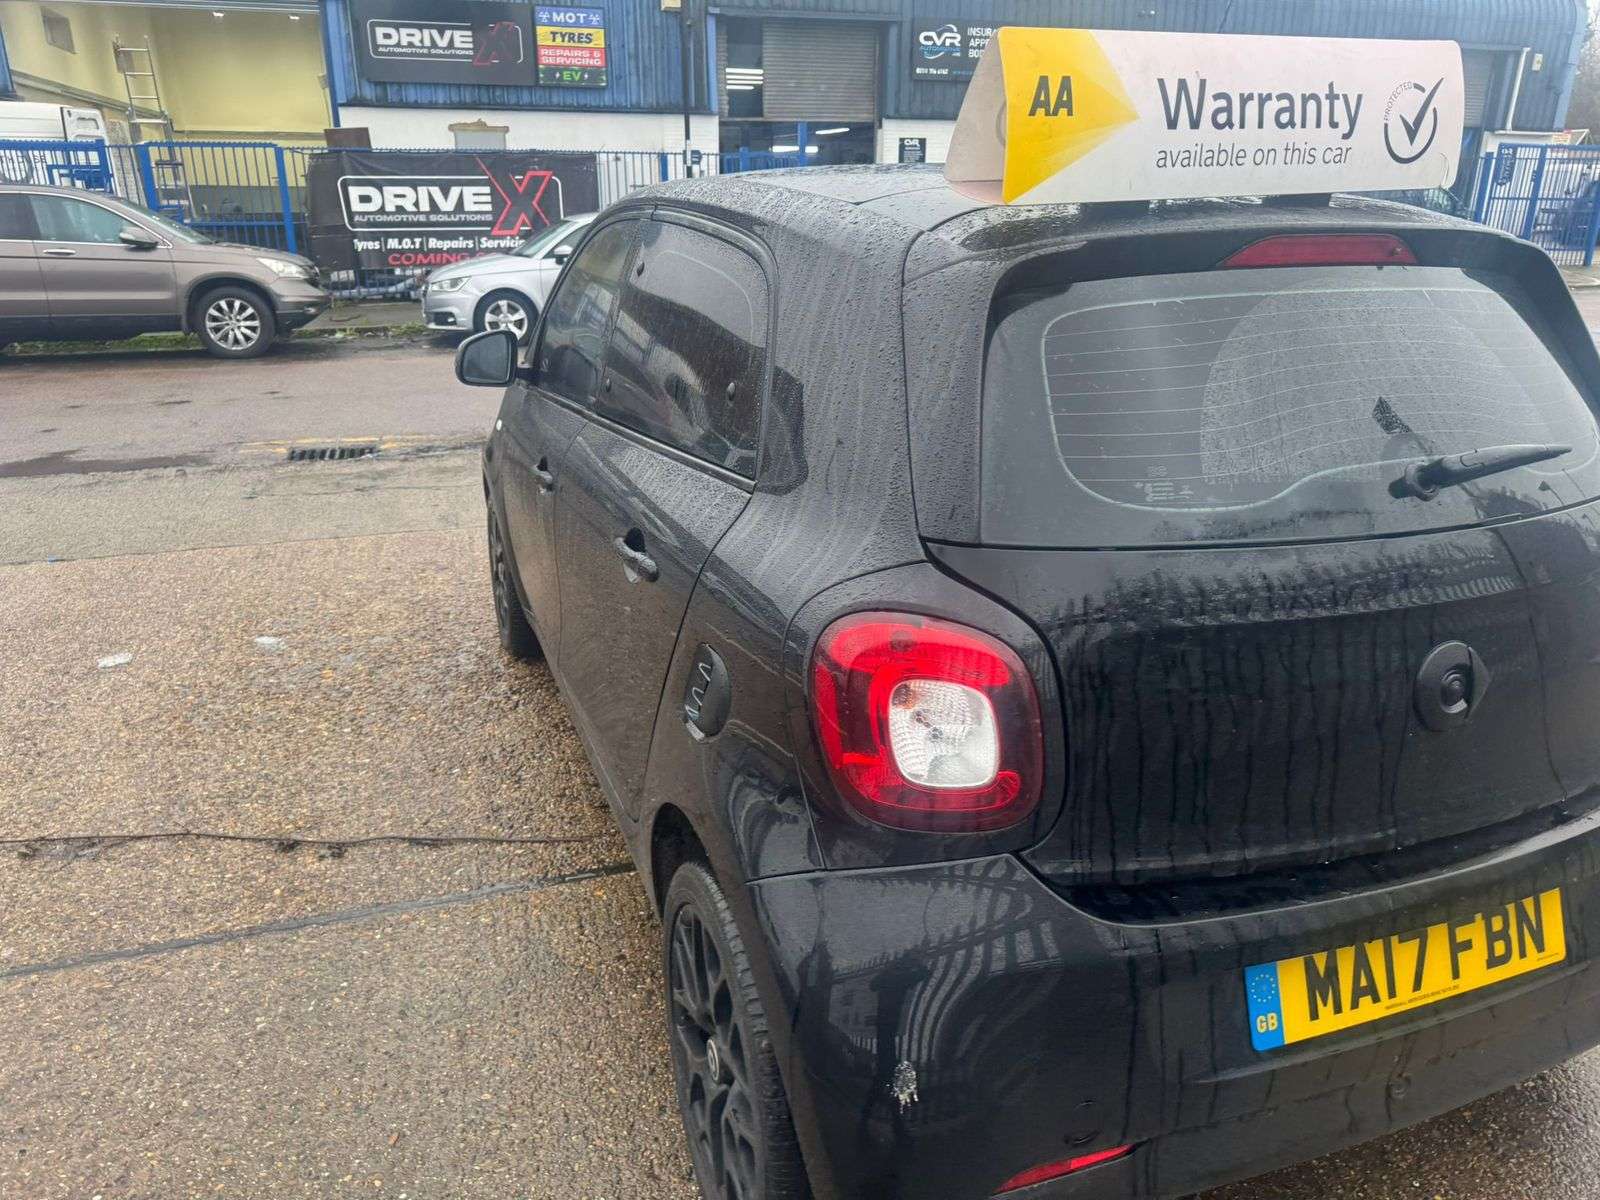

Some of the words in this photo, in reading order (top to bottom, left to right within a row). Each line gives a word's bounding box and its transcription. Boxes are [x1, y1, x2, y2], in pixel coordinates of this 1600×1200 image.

[552, 12, 587, 23] MOT
[375, 26, 474, 48] DRIVE
[550, 31, 593, 43] TYRES
[919, 31, 961, 47] CVR
[378, 46, 427, 54] AUTOMOTIVE
[431, 48, 474, 56] SOLUTIONS
[541, 48, 589, 57] REPAIRS
[542, 56, 601, 65] SERVICING
[562, 71, 582, 81] EV
[1028, 74, 1075, 118] AA
[1156, 77, 1363, 139] Warranty
[1156, 142, 1247, 168] available
[1252, 146, 1278, 165] on
[1284, 143, 1315, 164] this
[1321, 142, 1352, 164] car
[347, 186, 492, 212] DRIVE
[354, 214, 426, 222] AUTOMOTIVE
[430, 214, 493, 222] SOLUTIONS
[387, 237, 421, 249] M.O.T
[428, 237, 474, 250] Repairs
[1303, 928, 1429, 1021] MA17
[1447, 891, 1547, 981] FBN
[1256, 1012, 1278, 1033] GB
